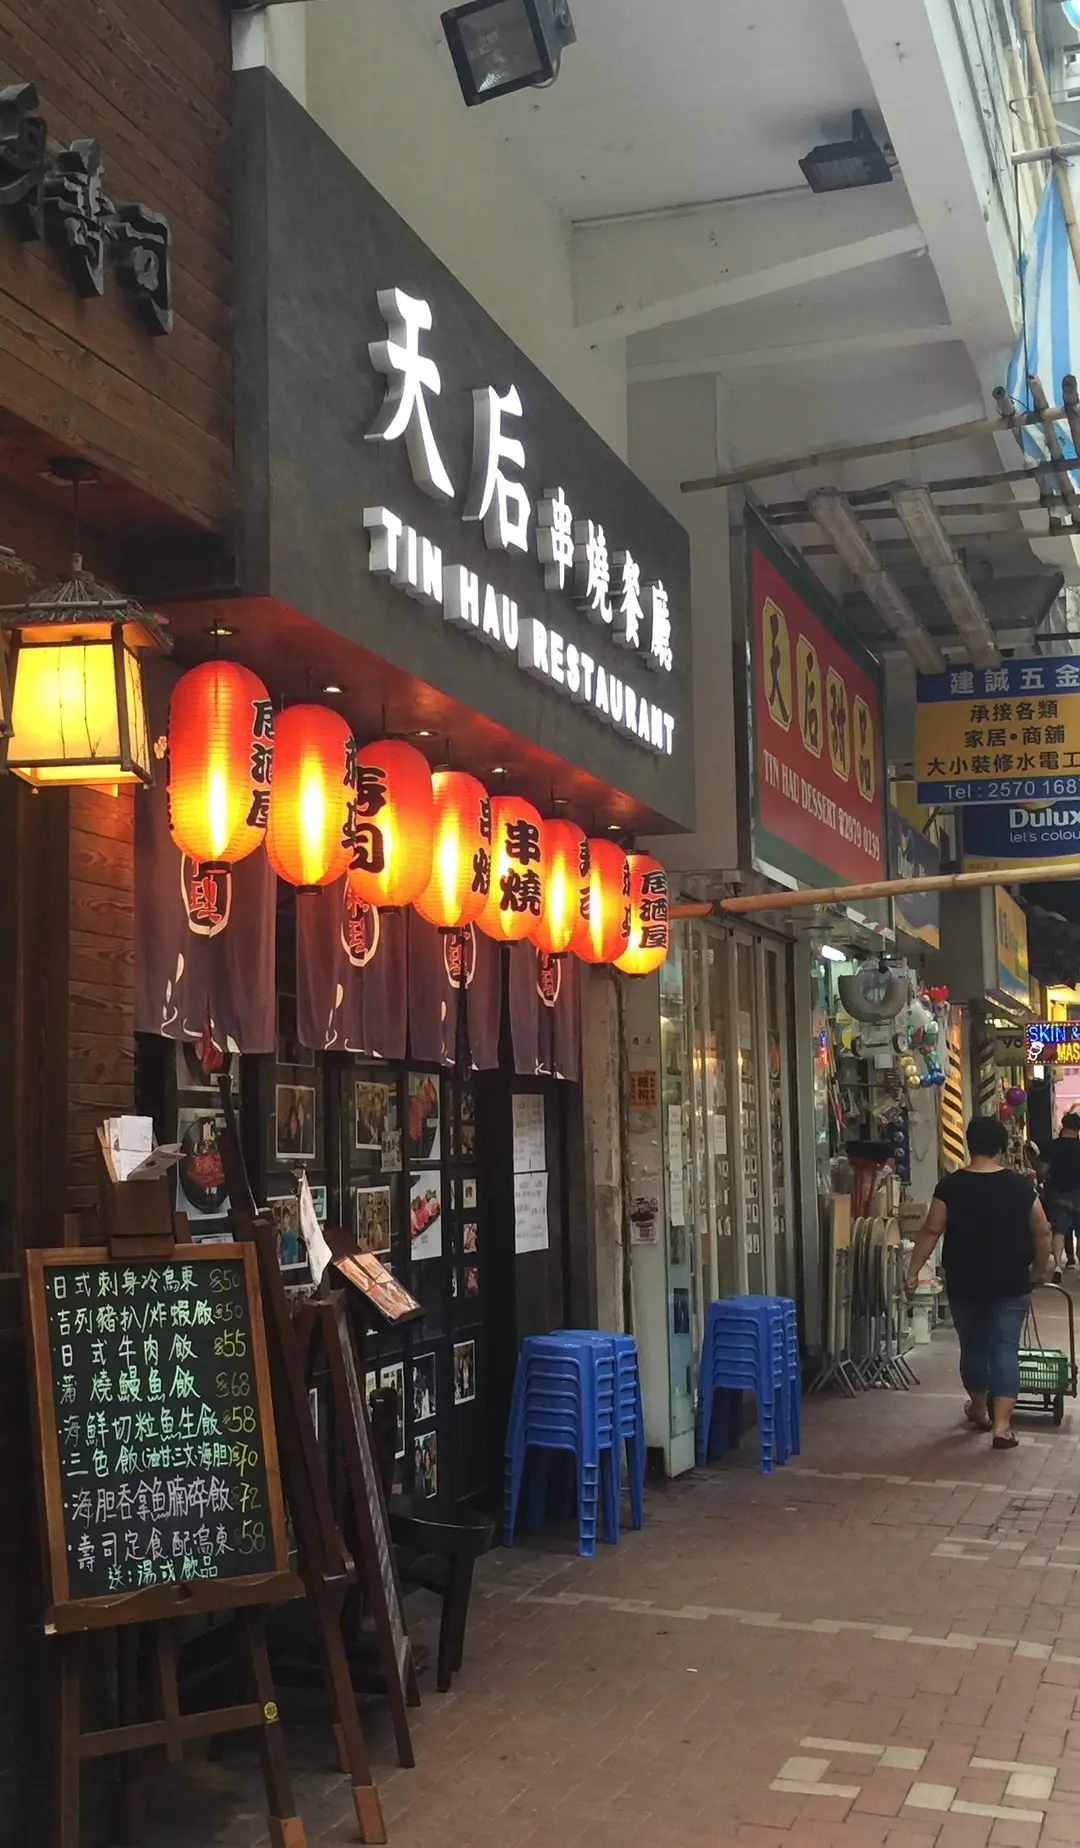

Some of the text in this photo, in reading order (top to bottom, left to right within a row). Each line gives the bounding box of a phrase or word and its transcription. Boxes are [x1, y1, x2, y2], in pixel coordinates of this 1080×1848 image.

[370, 507, 675, 756] TIN HAU RESTAURANT
[950, 664, 1080, 695] 建誠五金
[970, 700, 1058, 723] 承接各類
[926, 751, 1080, 776] 大小裝修水電工
[763, 748, 779, 790] TIN
[781, 762, 800, 804] HAU
[801, 778, 836, 830] DESSERT
[988, 781, 1035, 798] 2570
[1043, 779, 1080, 795] 168
[1009, 808, 1080, 829] Dulux
[1010, 831, 1037, 843] let's
[500, 820, 541, 917] 串燒
[640, 870, 668, 949] 居酒屋
[1029, 1024, 1066, 1042] SKIN
[62, 1333, 198, 1367] 日式牛肉飯
